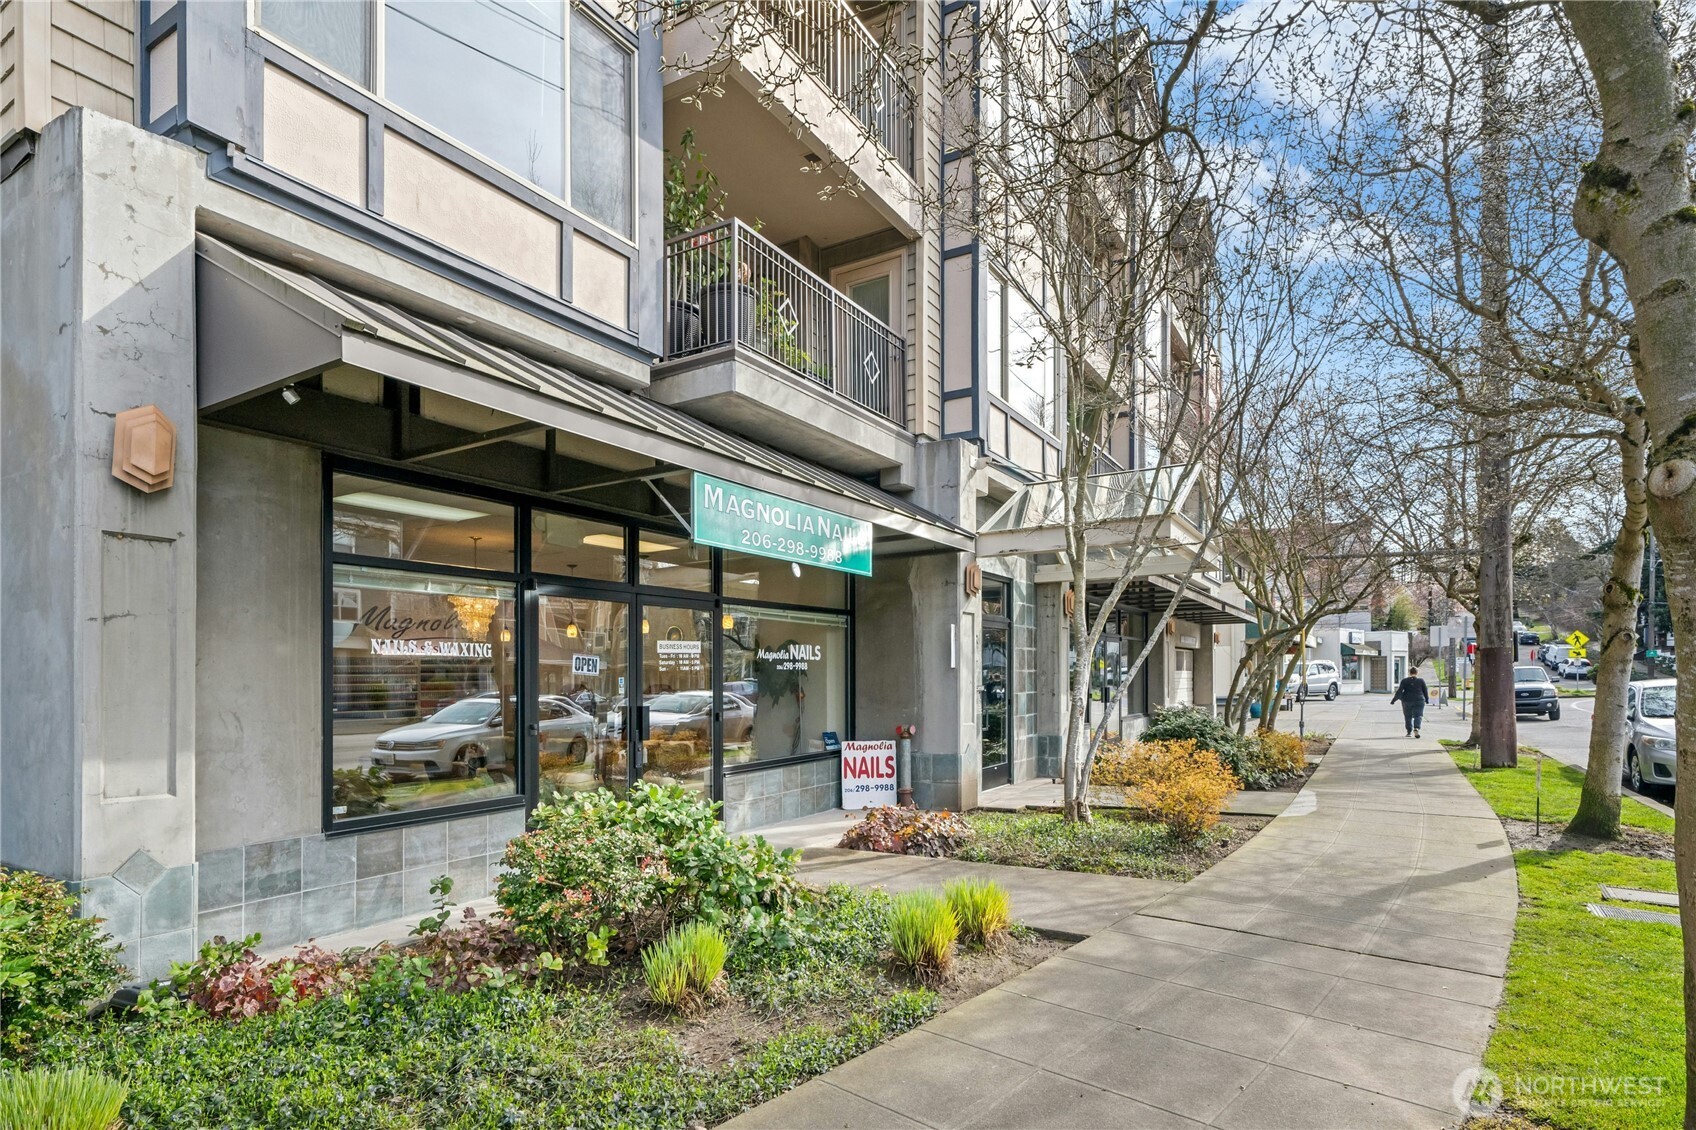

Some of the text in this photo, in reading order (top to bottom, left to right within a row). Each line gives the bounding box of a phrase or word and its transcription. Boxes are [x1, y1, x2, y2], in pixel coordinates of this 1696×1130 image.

[703, 483, 815, 535] MAGNOLIA
[741, 529, 843, 564] 206-298-9988
[370, 638, 417, 655] NAILS
[438, 641, 492, 657] WAXING
[756, 644, 821, 662] Magnolia NAILS
[574, 656, 598, 673] OPEN
[844, 742, 893, 753] Magnolia
[843, 755, 895, 779] NAILS
